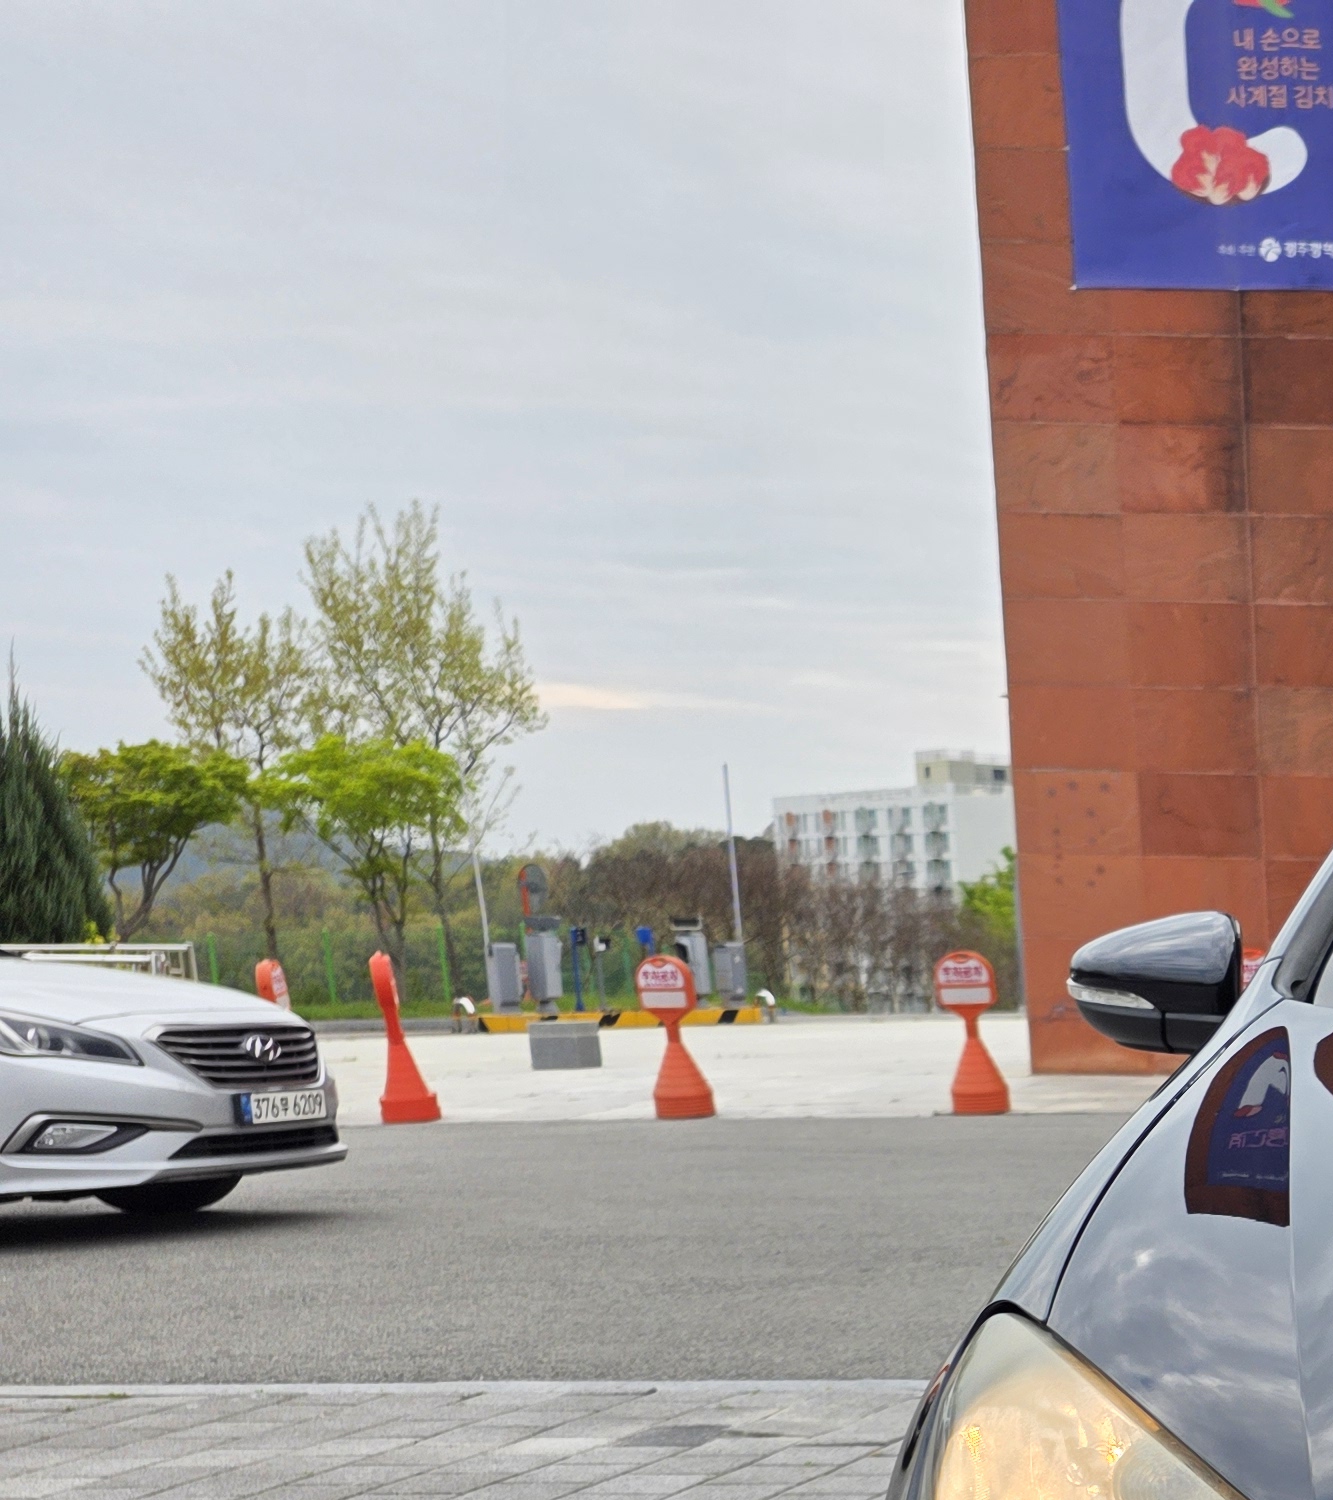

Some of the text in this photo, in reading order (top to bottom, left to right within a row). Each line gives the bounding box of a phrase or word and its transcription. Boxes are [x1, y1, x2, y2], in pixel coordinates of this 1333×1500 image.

[1233, 27, 1322, 51] 내 손으로
[1237, 56, 1320, 81] 완성하는
[1226, 84, 1288, 109] 사계절
[253, 1092, 324, 1120] 376무 6209
